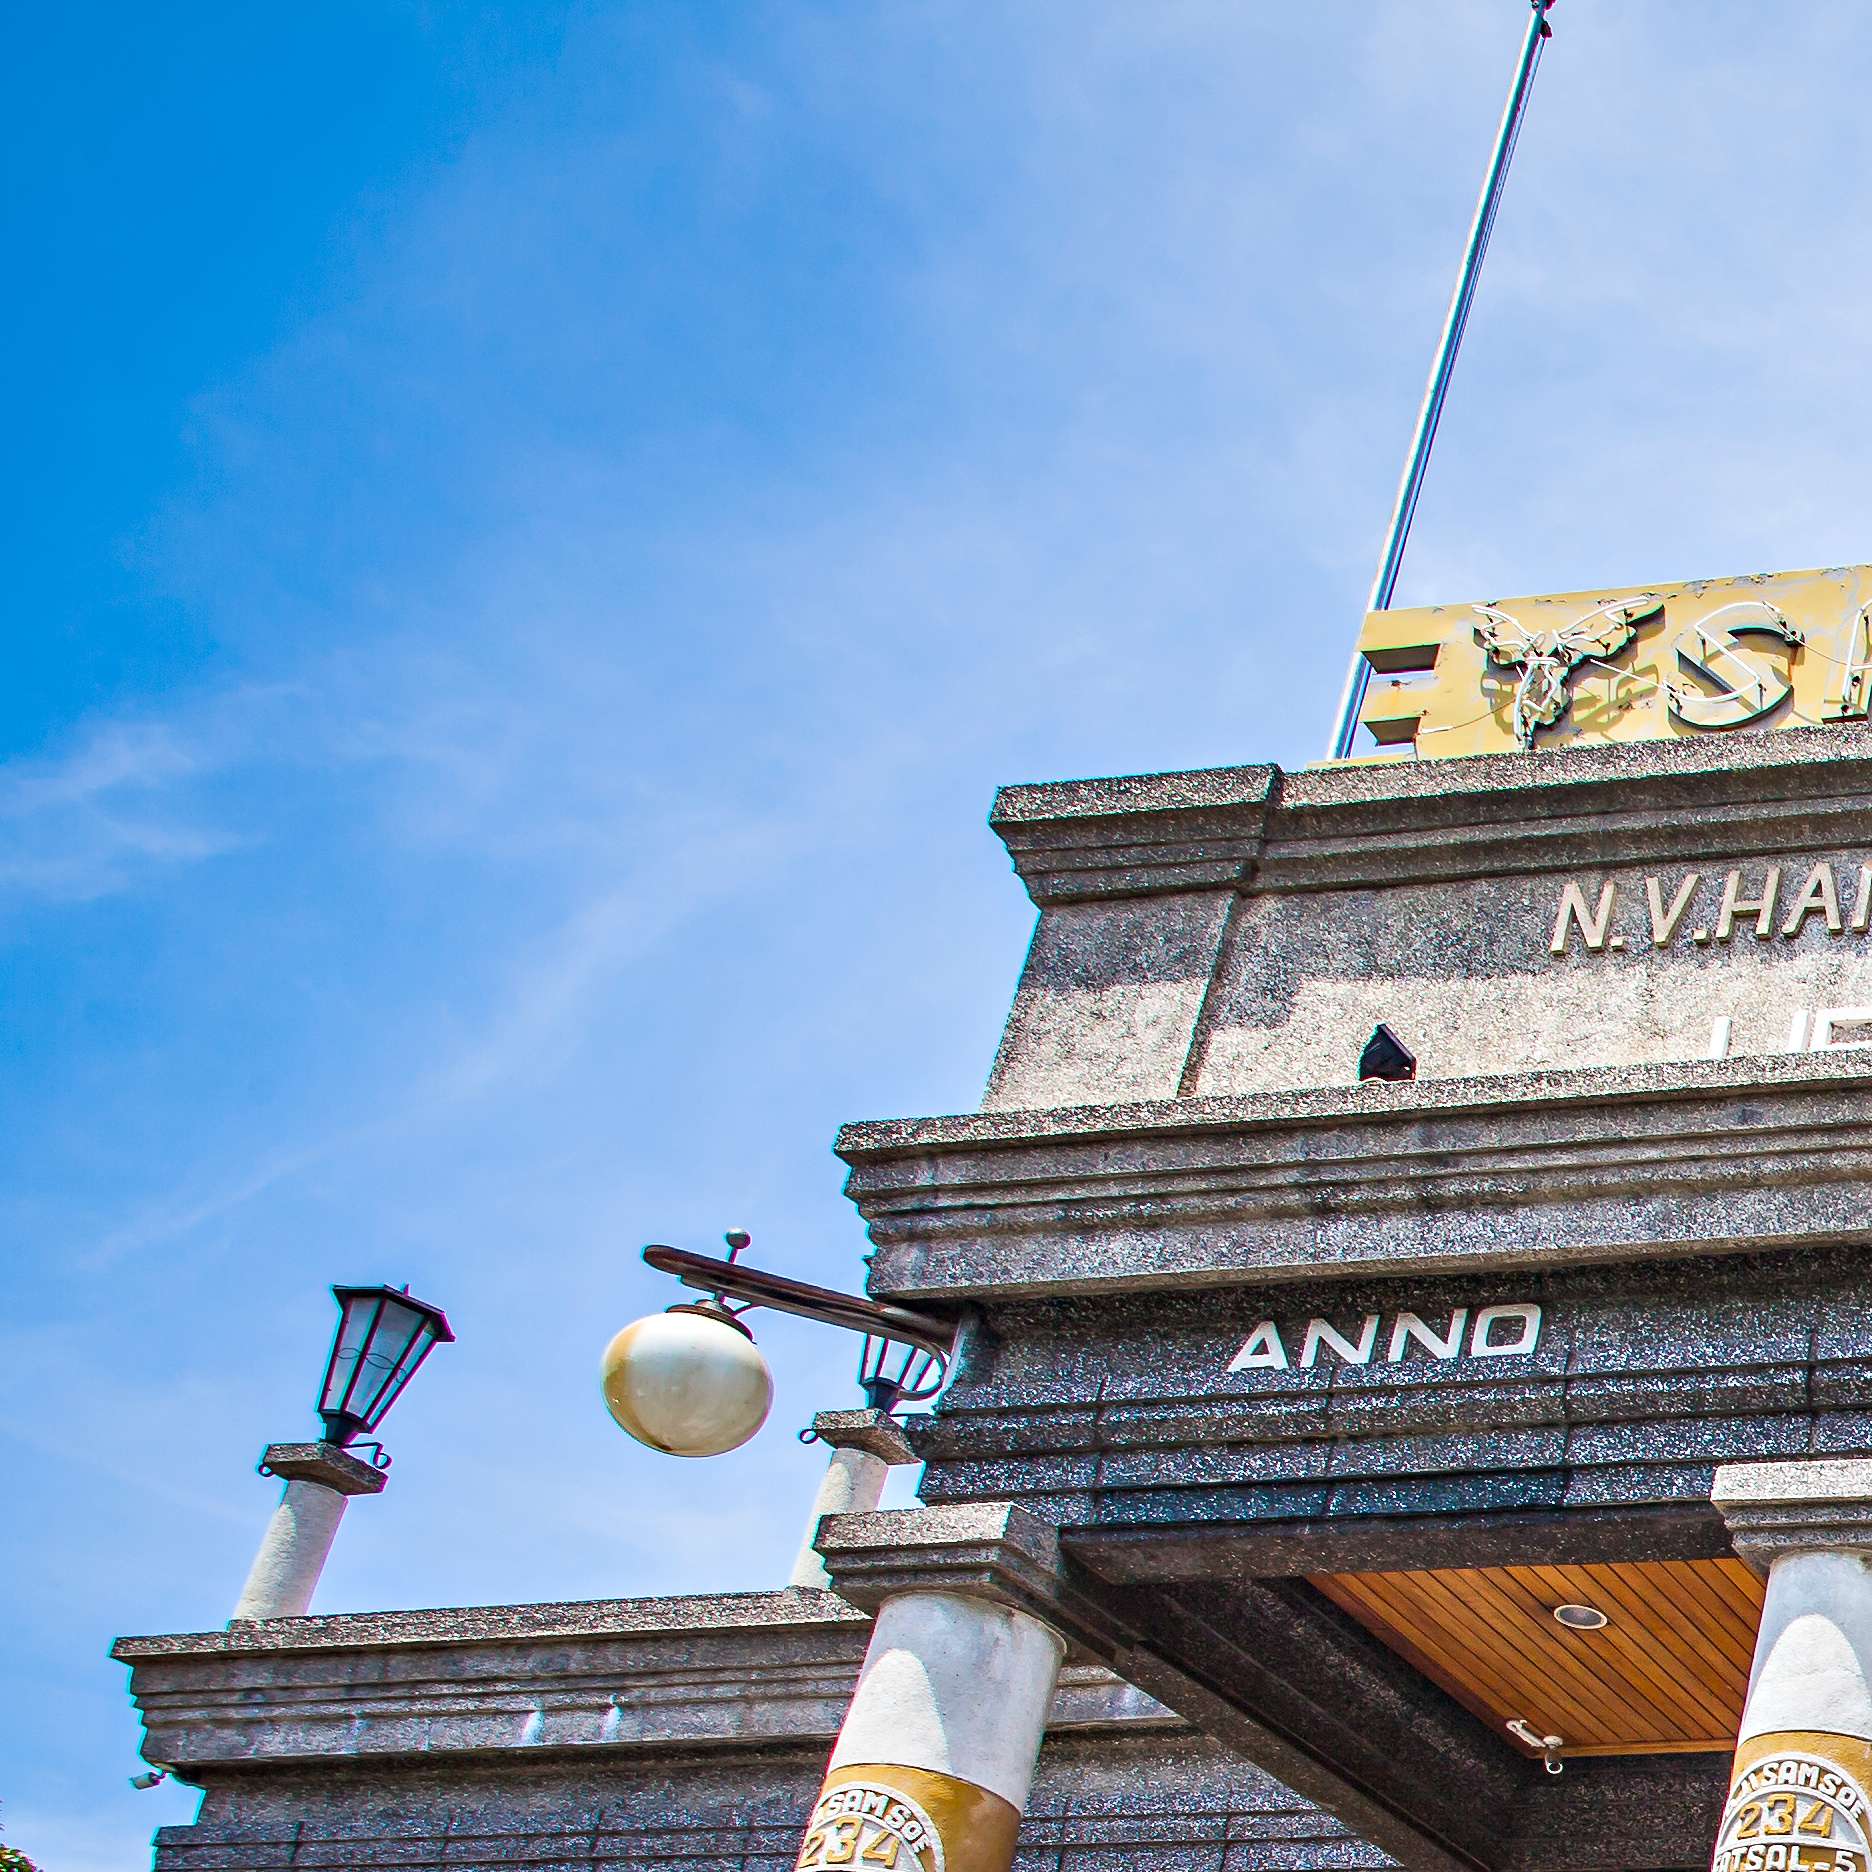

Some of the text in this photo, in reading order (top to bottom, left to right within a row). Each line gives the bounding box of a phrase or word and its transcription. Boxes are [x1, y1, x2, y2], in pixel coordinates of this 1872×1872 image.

[1227, 1303, 1542, 1373] ANNO
[799, 1815, 903, 1868] 234
[1737, 1793, 1833, 1839] 234
